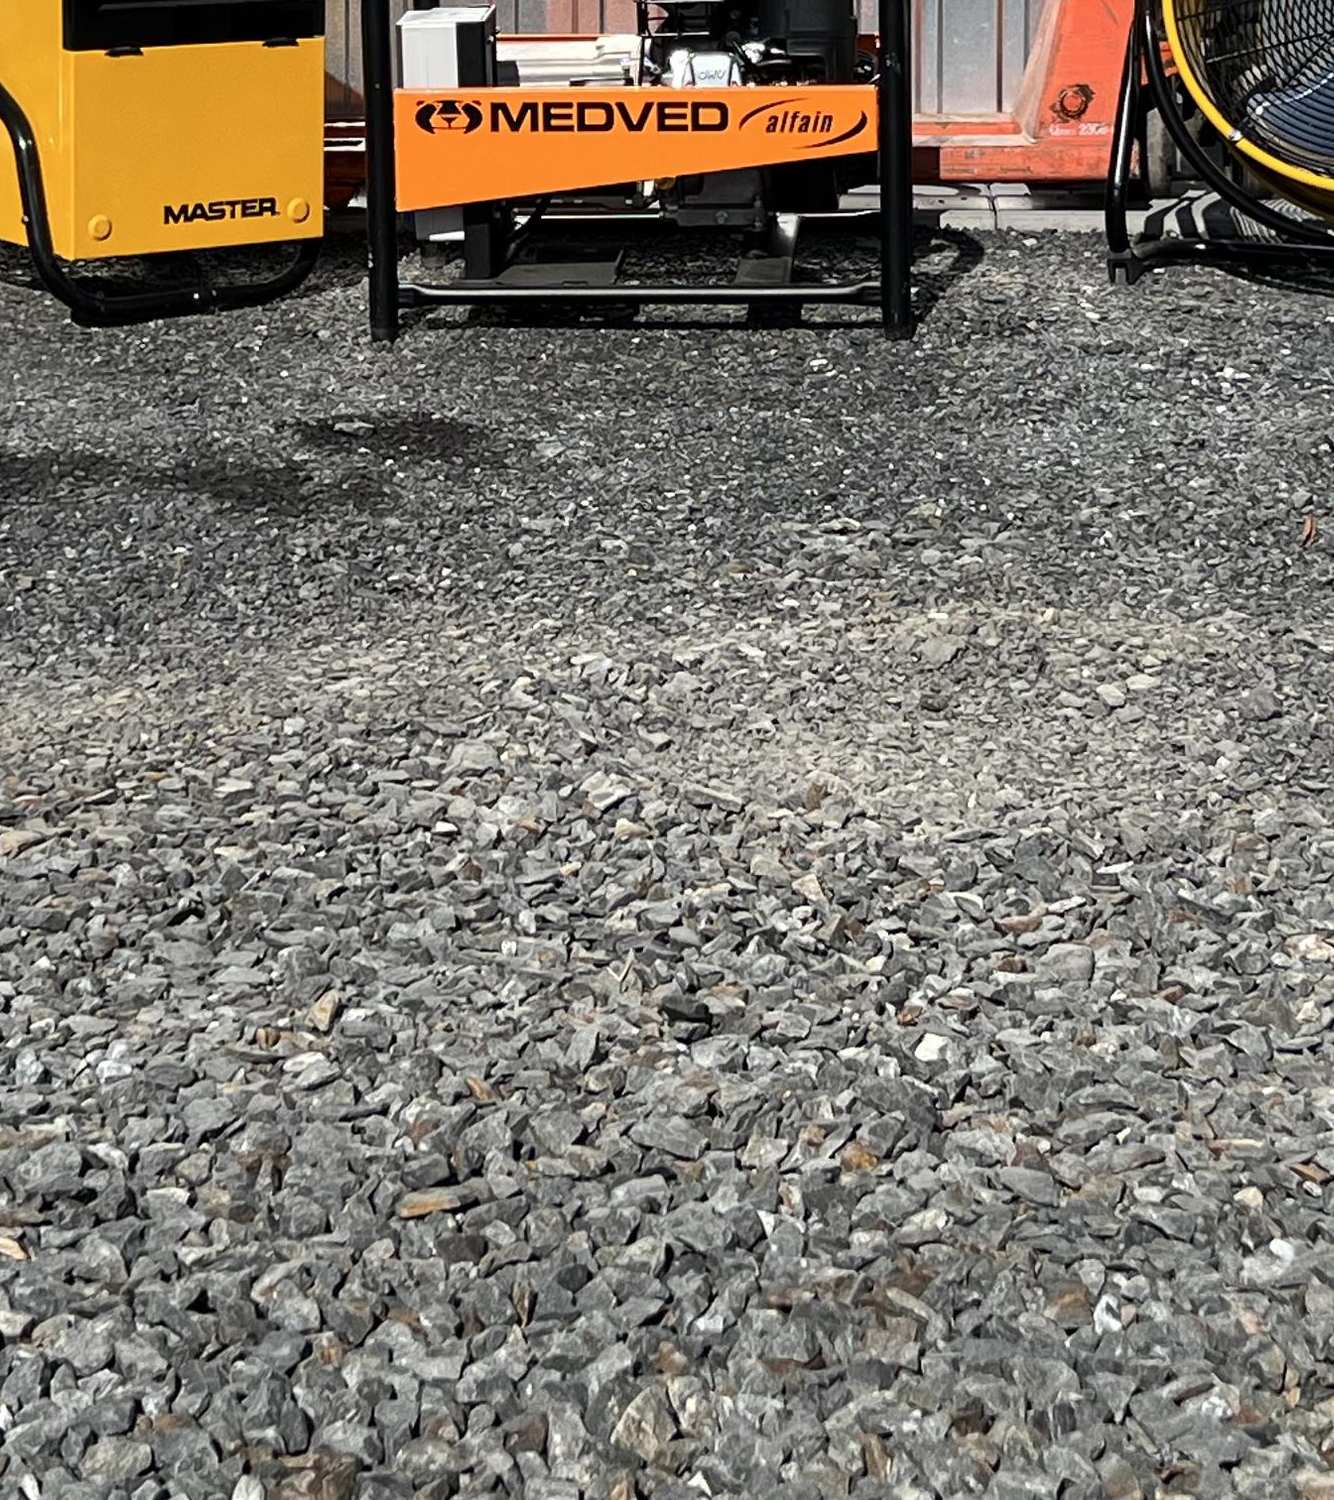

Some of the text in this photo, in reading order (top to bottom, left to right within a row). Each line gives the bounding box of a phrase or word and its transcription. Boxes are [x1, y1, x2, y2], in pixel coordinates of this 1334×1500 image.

[490, 101, 834, 133] MEDVED alfain
[163, 197, 277, 225] MASTER
